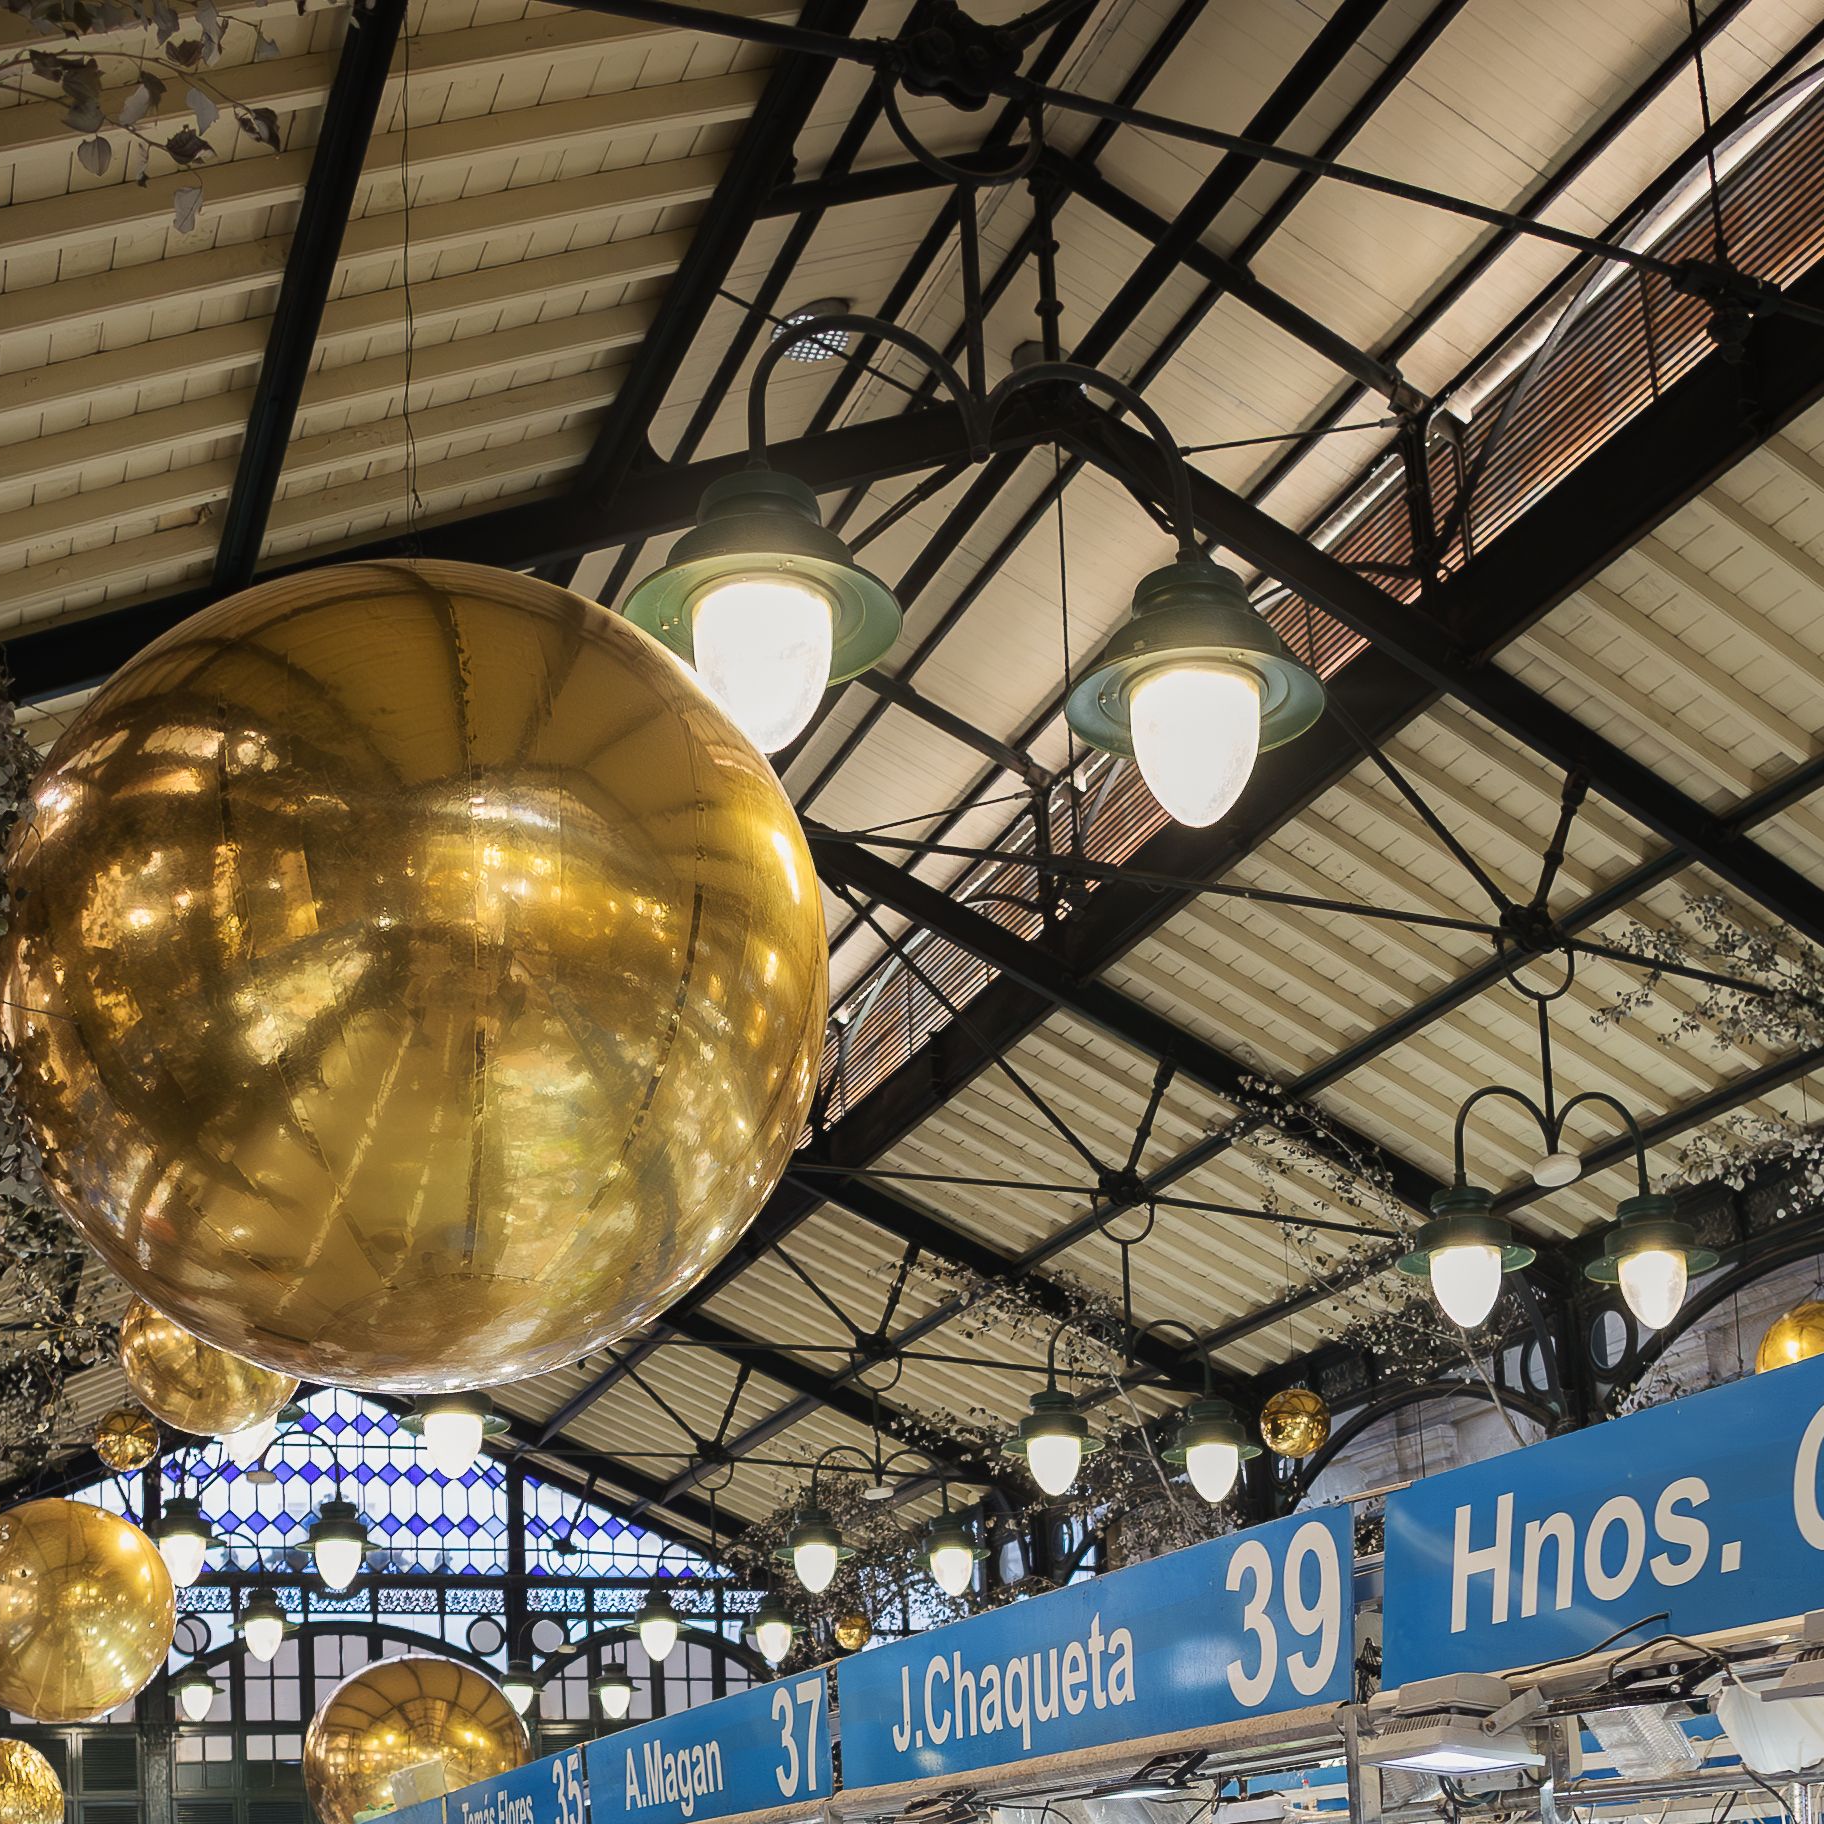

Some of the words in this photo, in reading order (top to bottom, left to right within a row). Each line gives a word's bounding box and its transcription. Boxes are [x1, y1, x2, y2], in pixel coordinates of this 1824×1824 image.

[1450, 1477, 1742, 1633] Hnos.
[890, 1612, 1137, 1754] J.Chaqueta
[1222, 1519, 1342, 1708] 39
[623, 1736, 725, 1818] A.Magan
[770, 1674, 824, 1800] 37
